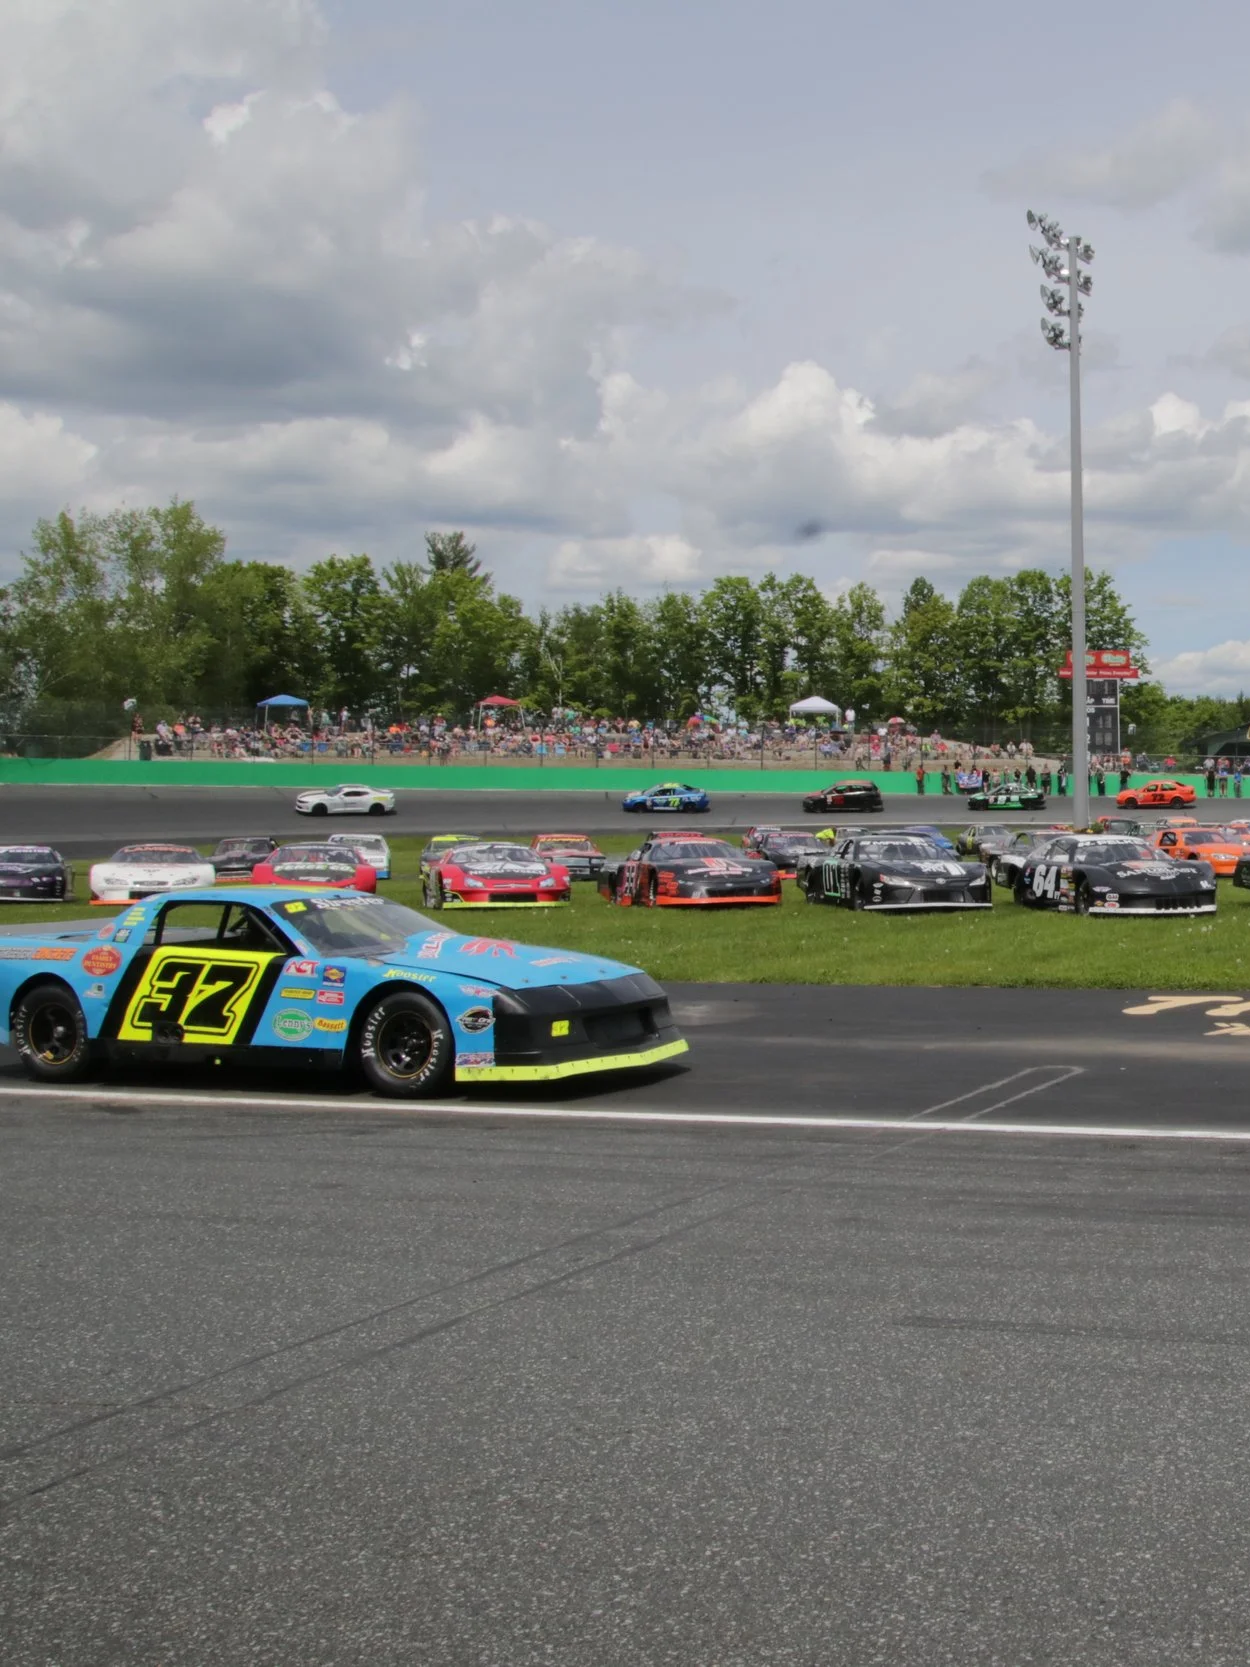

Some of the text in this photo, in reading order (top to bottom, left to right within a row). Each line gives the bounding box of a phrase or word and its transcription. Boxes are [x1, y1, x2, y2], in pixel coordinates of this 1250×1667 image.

[1032, 864, 1057, 899] 64
[286, 960, 320, 977] ACT
[383, 968, 437, 983] Hoosier
[133, 957, 258, 1035] 37
[361, 1006, 386, 1059] Hoosier
